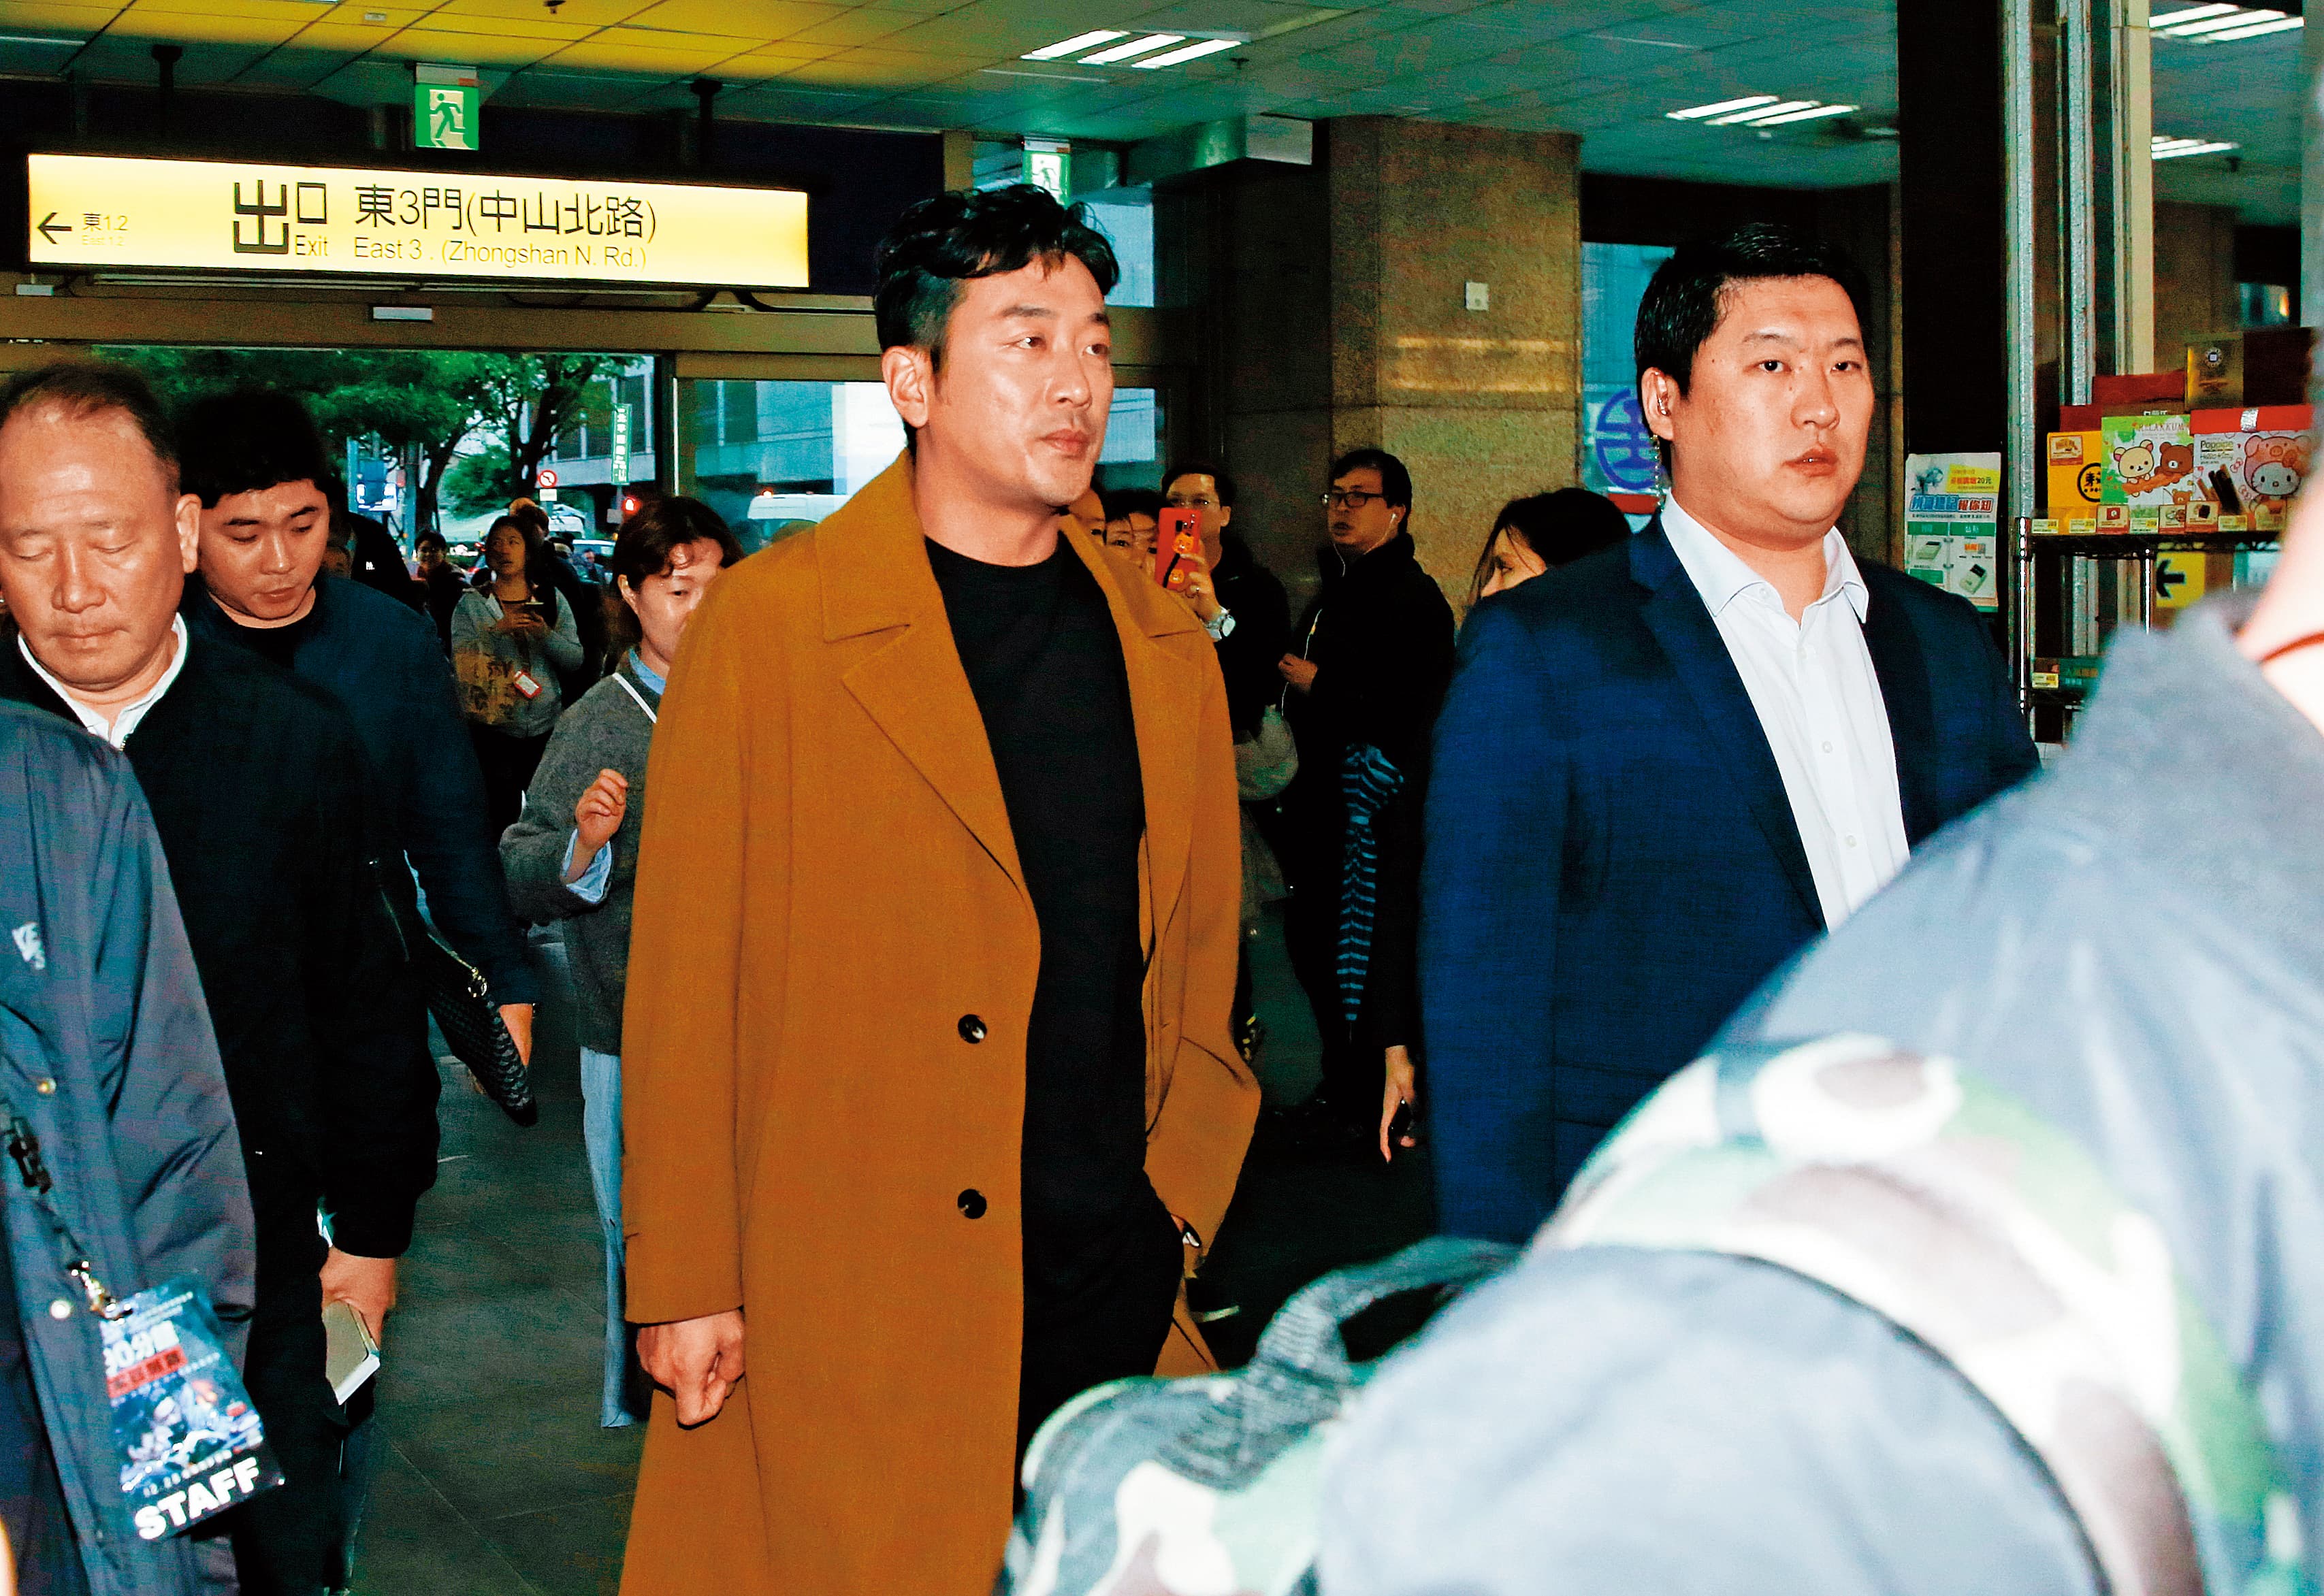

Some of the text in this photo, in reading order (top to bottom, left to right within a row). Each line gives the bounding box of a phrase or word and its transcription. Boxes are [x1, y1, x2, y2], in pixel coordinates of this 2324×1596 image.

[233, 179, 327, 255] 出口
[355, 184, 656, 244] 東3門(中山北路)
[295, 234, 328, 257] Exit
[354, 236, 403, 259] East
[442, 239, 568, 268] (Zhongshan
[575, 244, 596, 266] N.
[604, 246, 646, 273] Rd.)
[135, 1456, 259, 1540] STAFF
